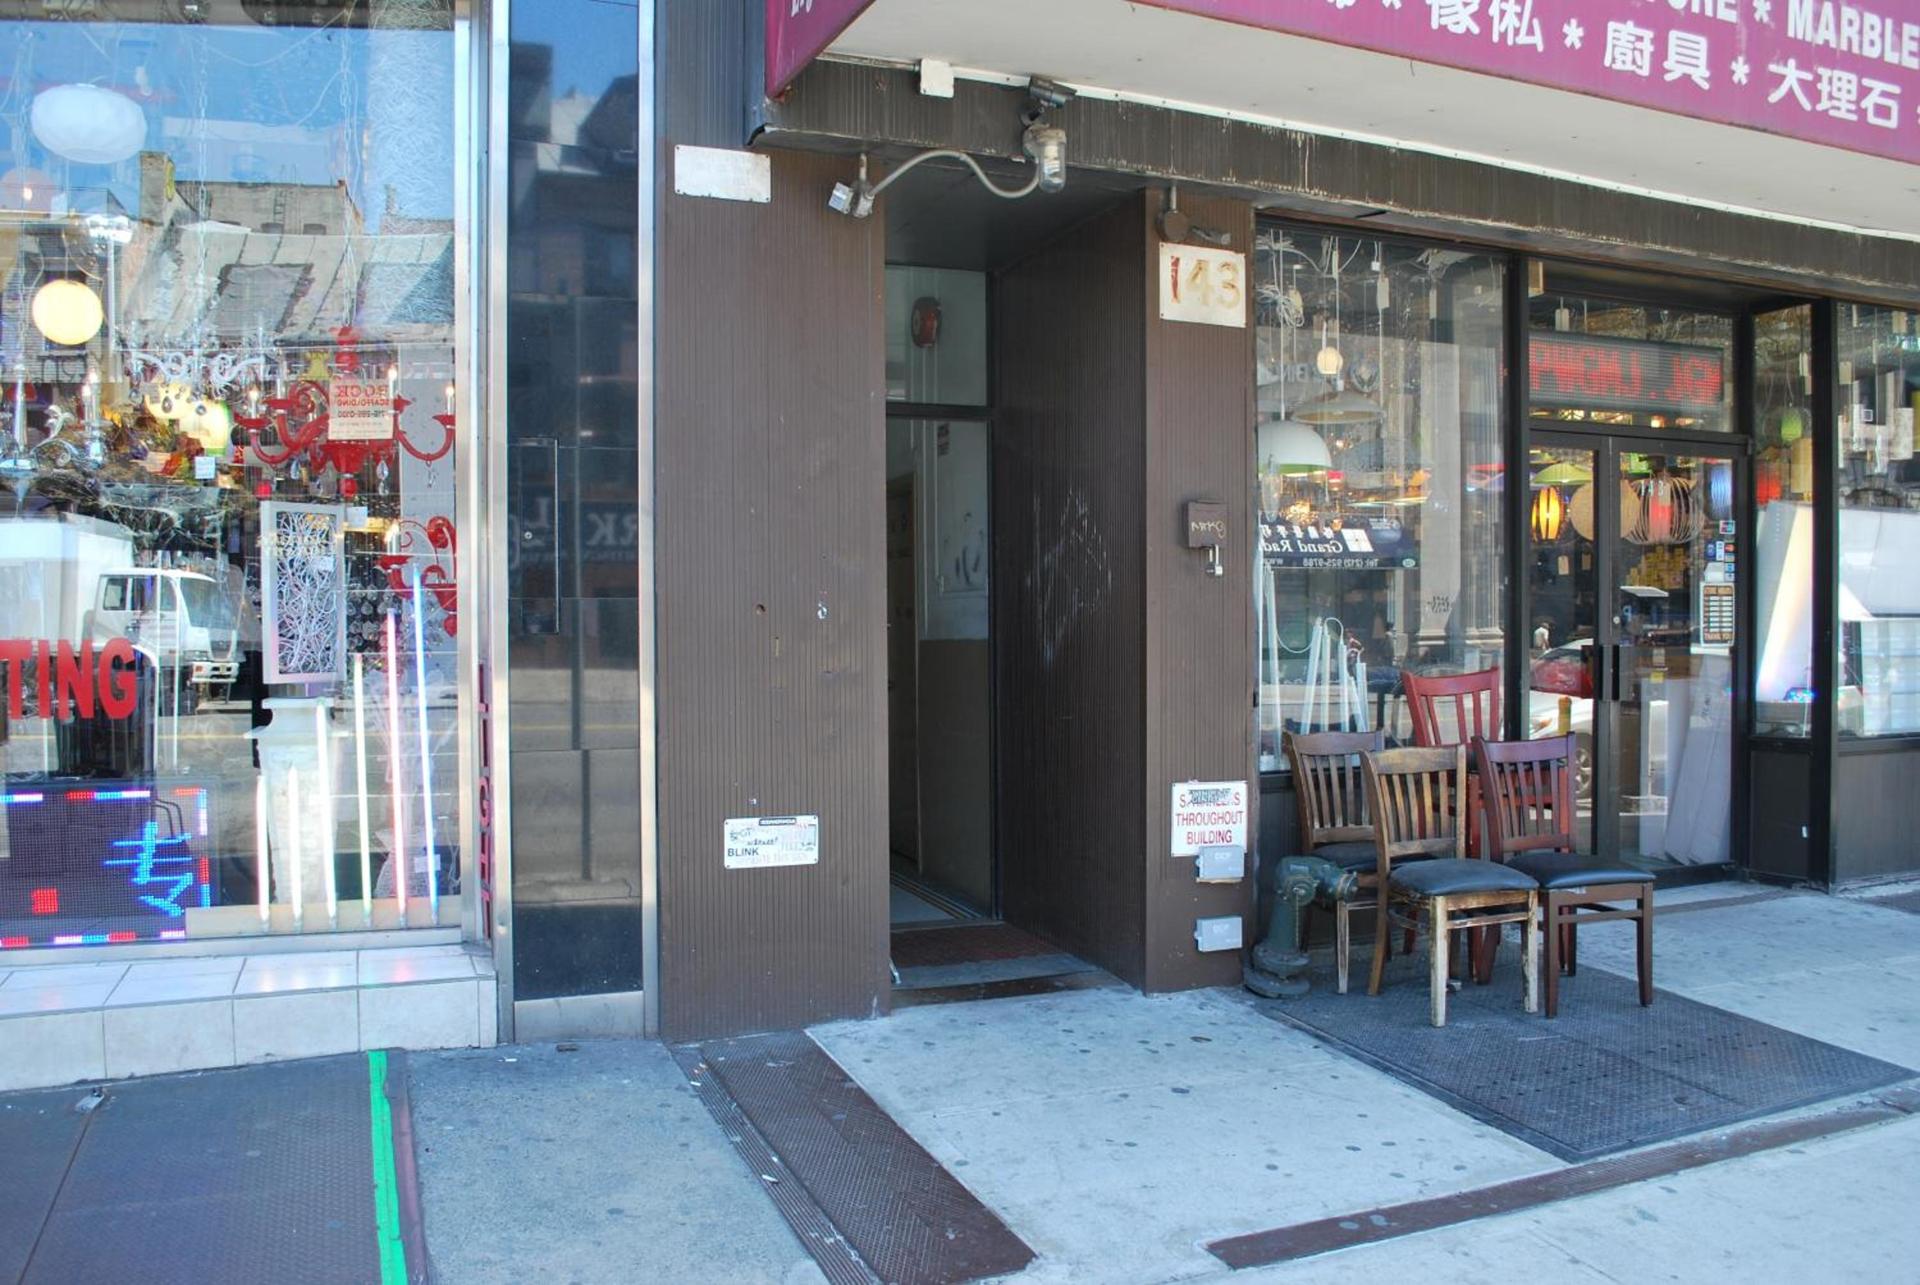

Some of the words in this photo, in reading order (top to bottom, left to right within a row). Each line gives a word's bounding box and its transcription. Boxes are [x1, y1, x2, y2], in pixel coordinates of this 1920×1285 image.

[1787, 0, 1920, 69] MARBLE
[1767, 58, 1902, 129] 大理石
[1170, 256, 1241, 309] 143
[0, 638, 137, 719] TING
[1176, 811, 1244, 826] THROUGHOUT
[1187, 829, 1232, 845] BUILDING
[727, 847, 760, 857] BLINK
